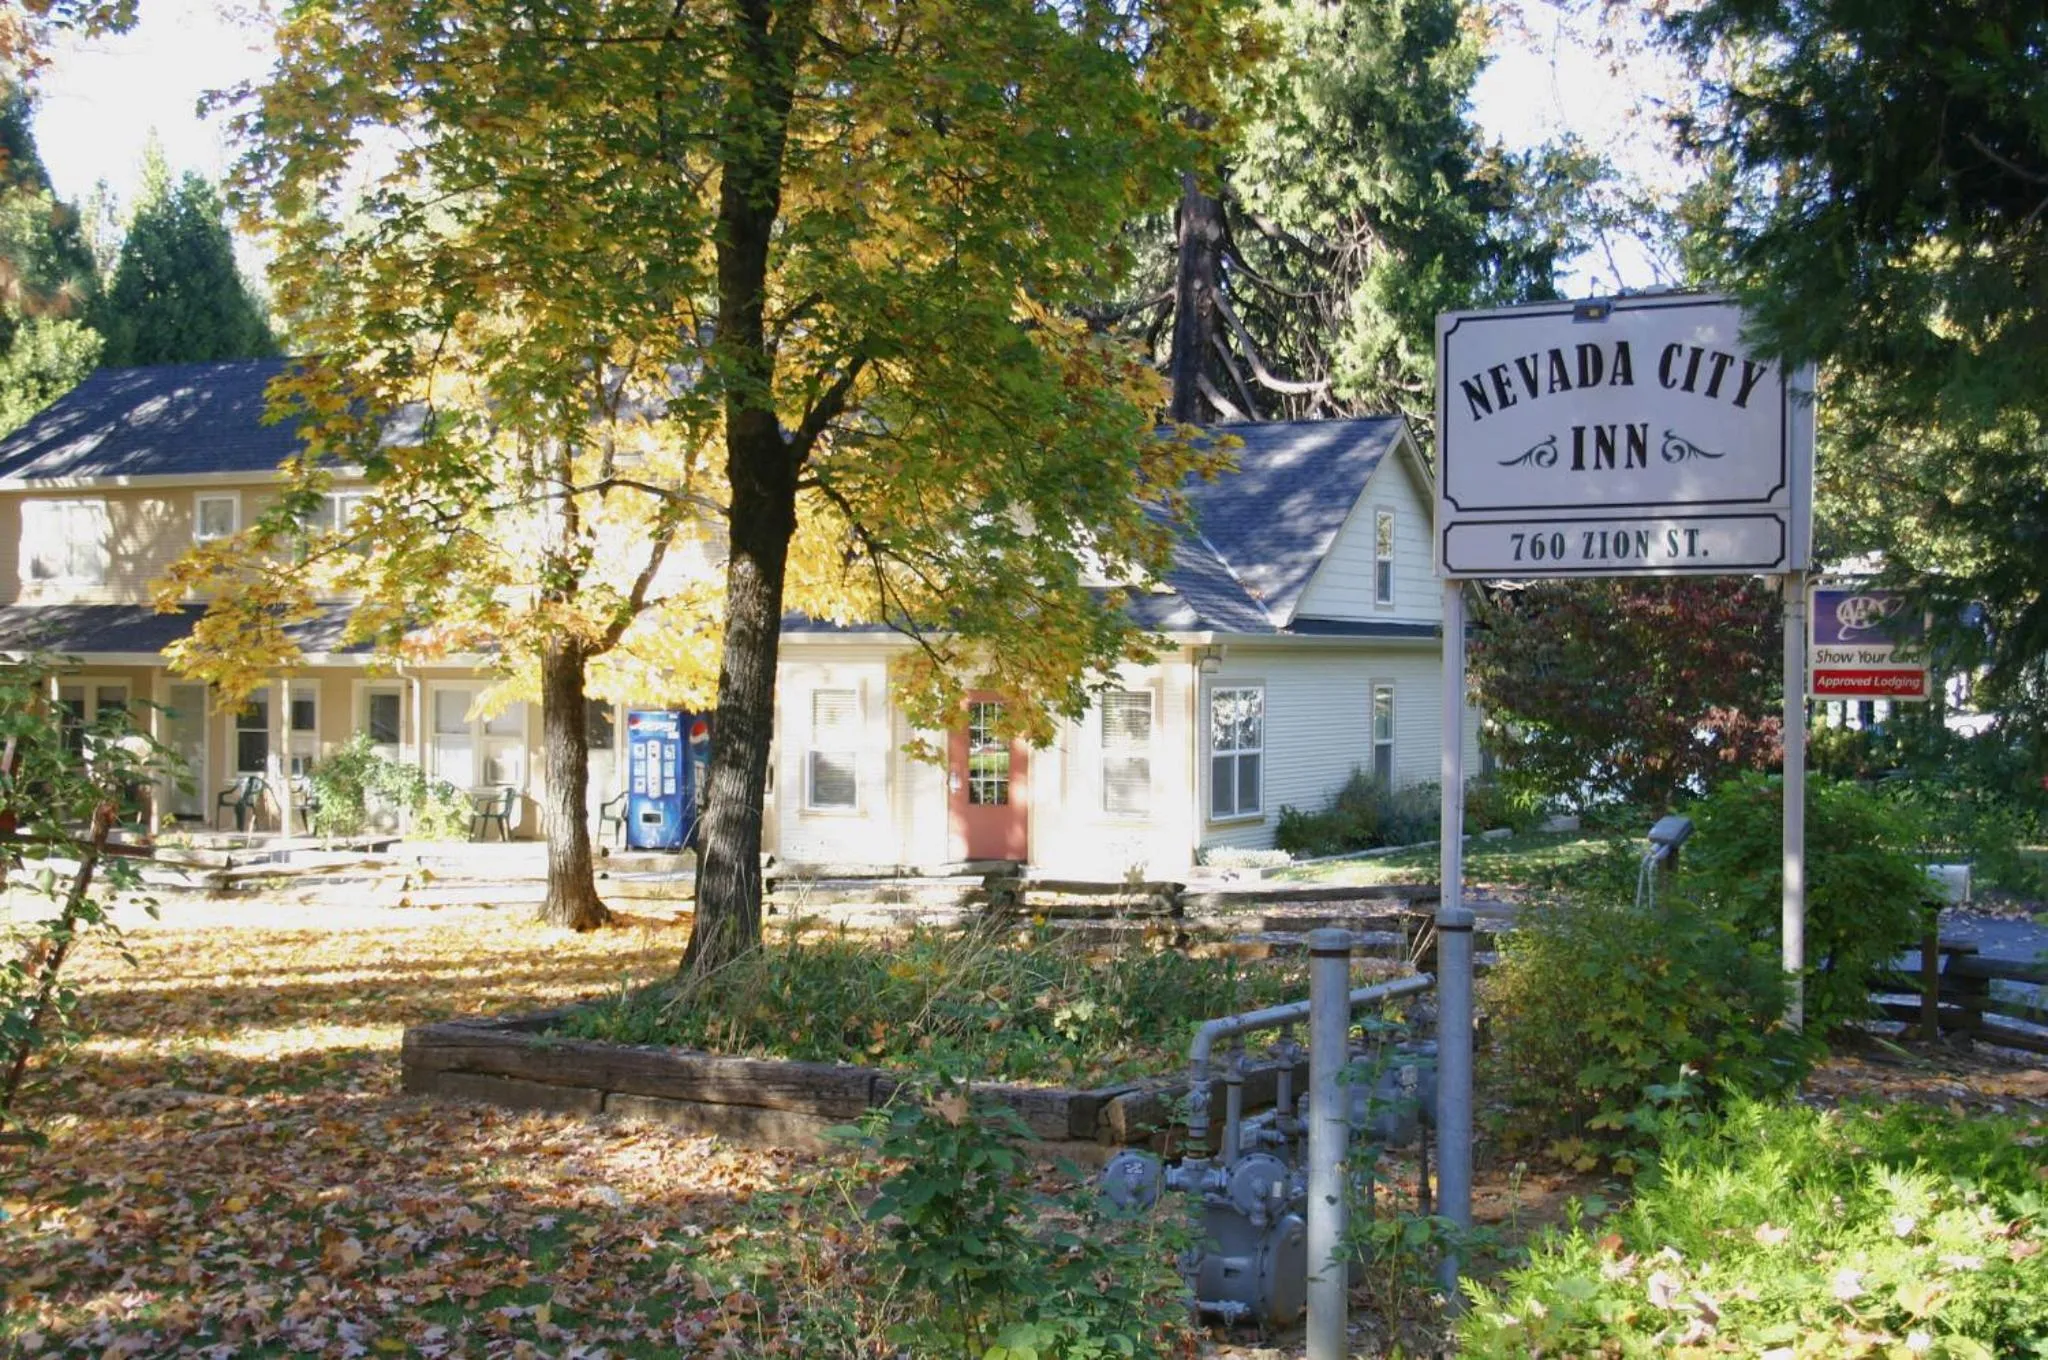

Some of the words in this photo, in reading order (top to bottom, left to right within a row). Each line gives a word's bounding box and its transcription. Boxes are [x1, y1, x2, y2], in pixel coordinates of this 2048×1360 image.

[1460, 341, 1634, 421] NEVADA
[1658, 343, 1767, 409] CITY
[1570, 423, 1649, 471] INN
[1510, 532, 1566, 561] 760
[1582, 530, 1649, 560] ZION
[1667, 528, 1709, 558] ST.
[1815, 650, 1853, 664] Show
[1858, 650, 1886, 664] Your
[1817, 676, 1871, 688] Approved
[1874, 676, 1920, 689] Lodging
